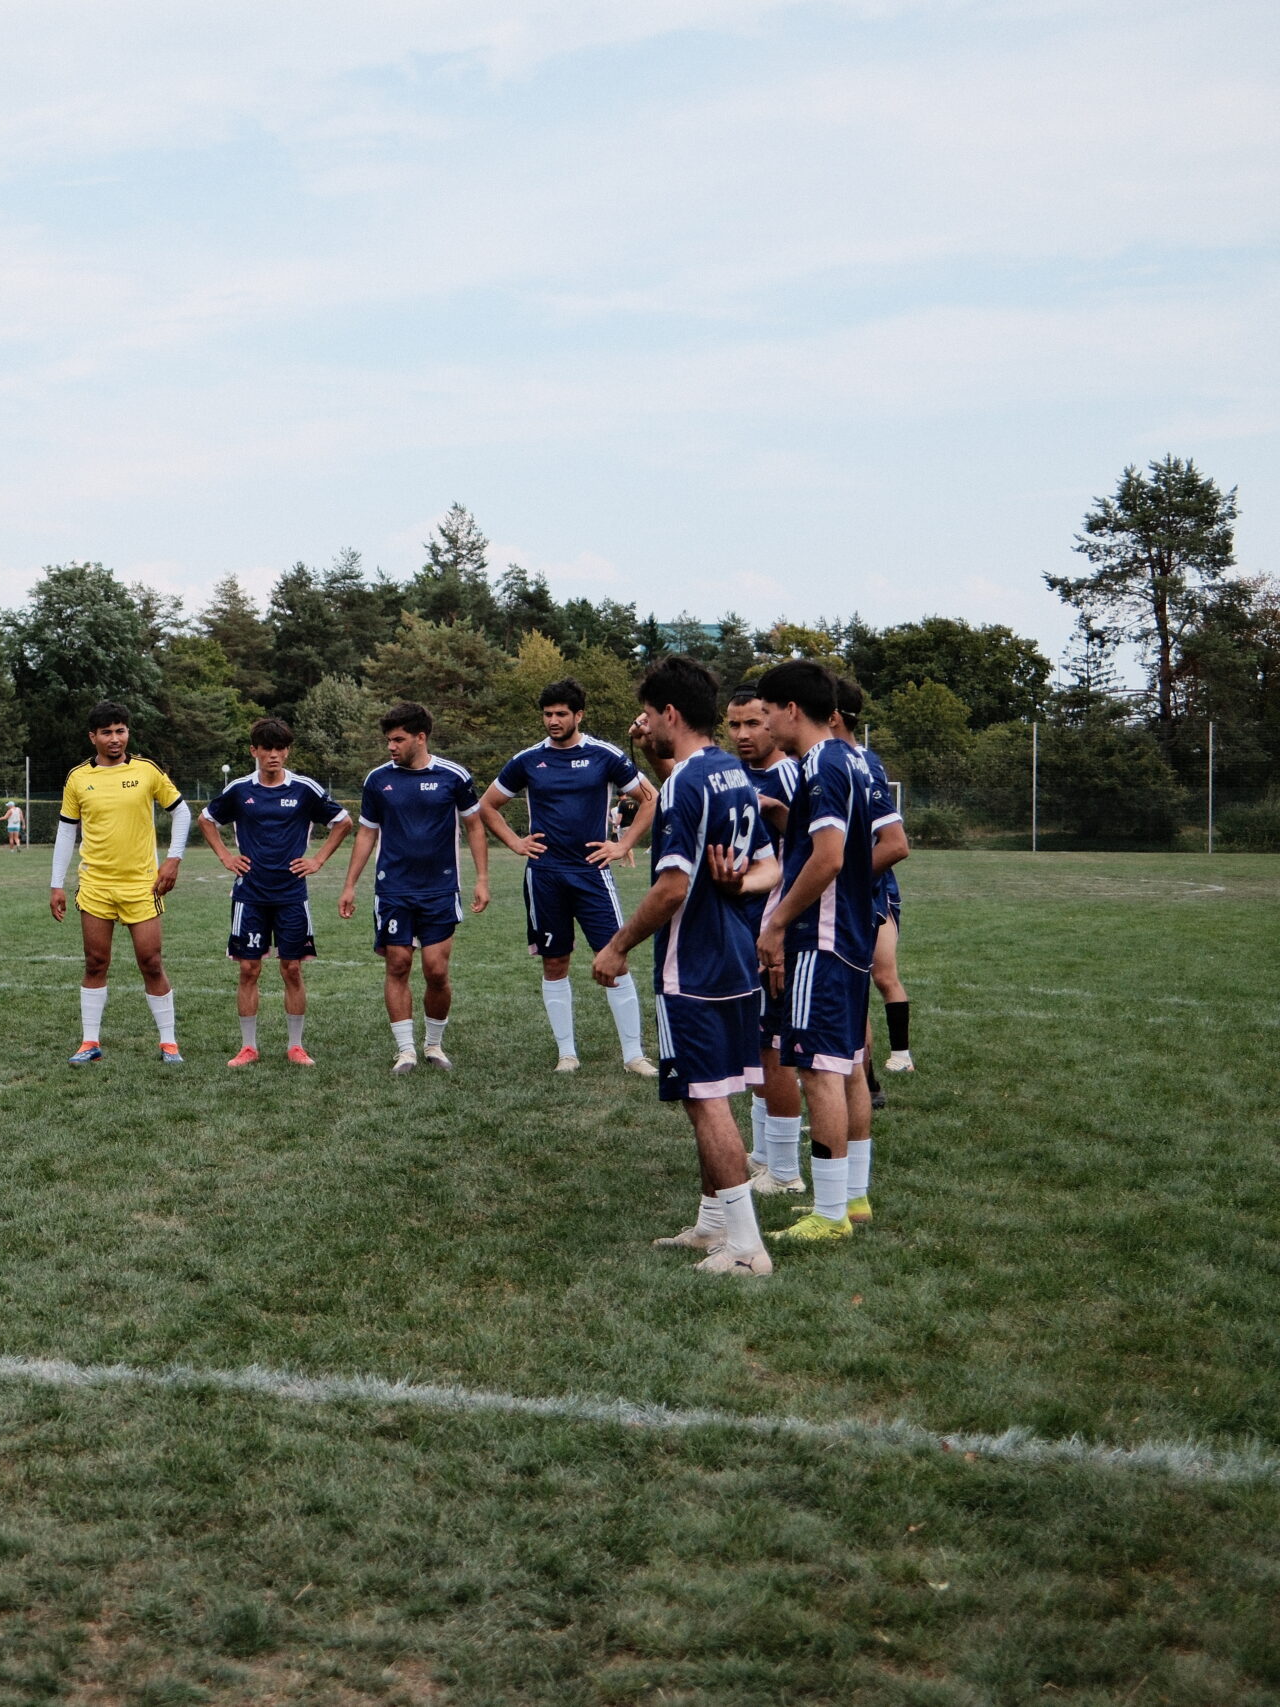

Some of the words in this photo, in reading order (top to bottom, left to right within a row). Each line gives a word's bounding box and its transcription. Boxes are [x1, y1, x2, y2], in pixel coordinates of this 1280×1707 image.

[570, 759, 590, 769] ECAP
[121, 780, 139, 789] ECAP
[420, 782, 438, 791] ECAP
[280, 798, 298, 808] ECAP
[387, 918, 398, 935] 8
[246, 932, 262, 948] 14
[544, 931, 553, 948] 7
